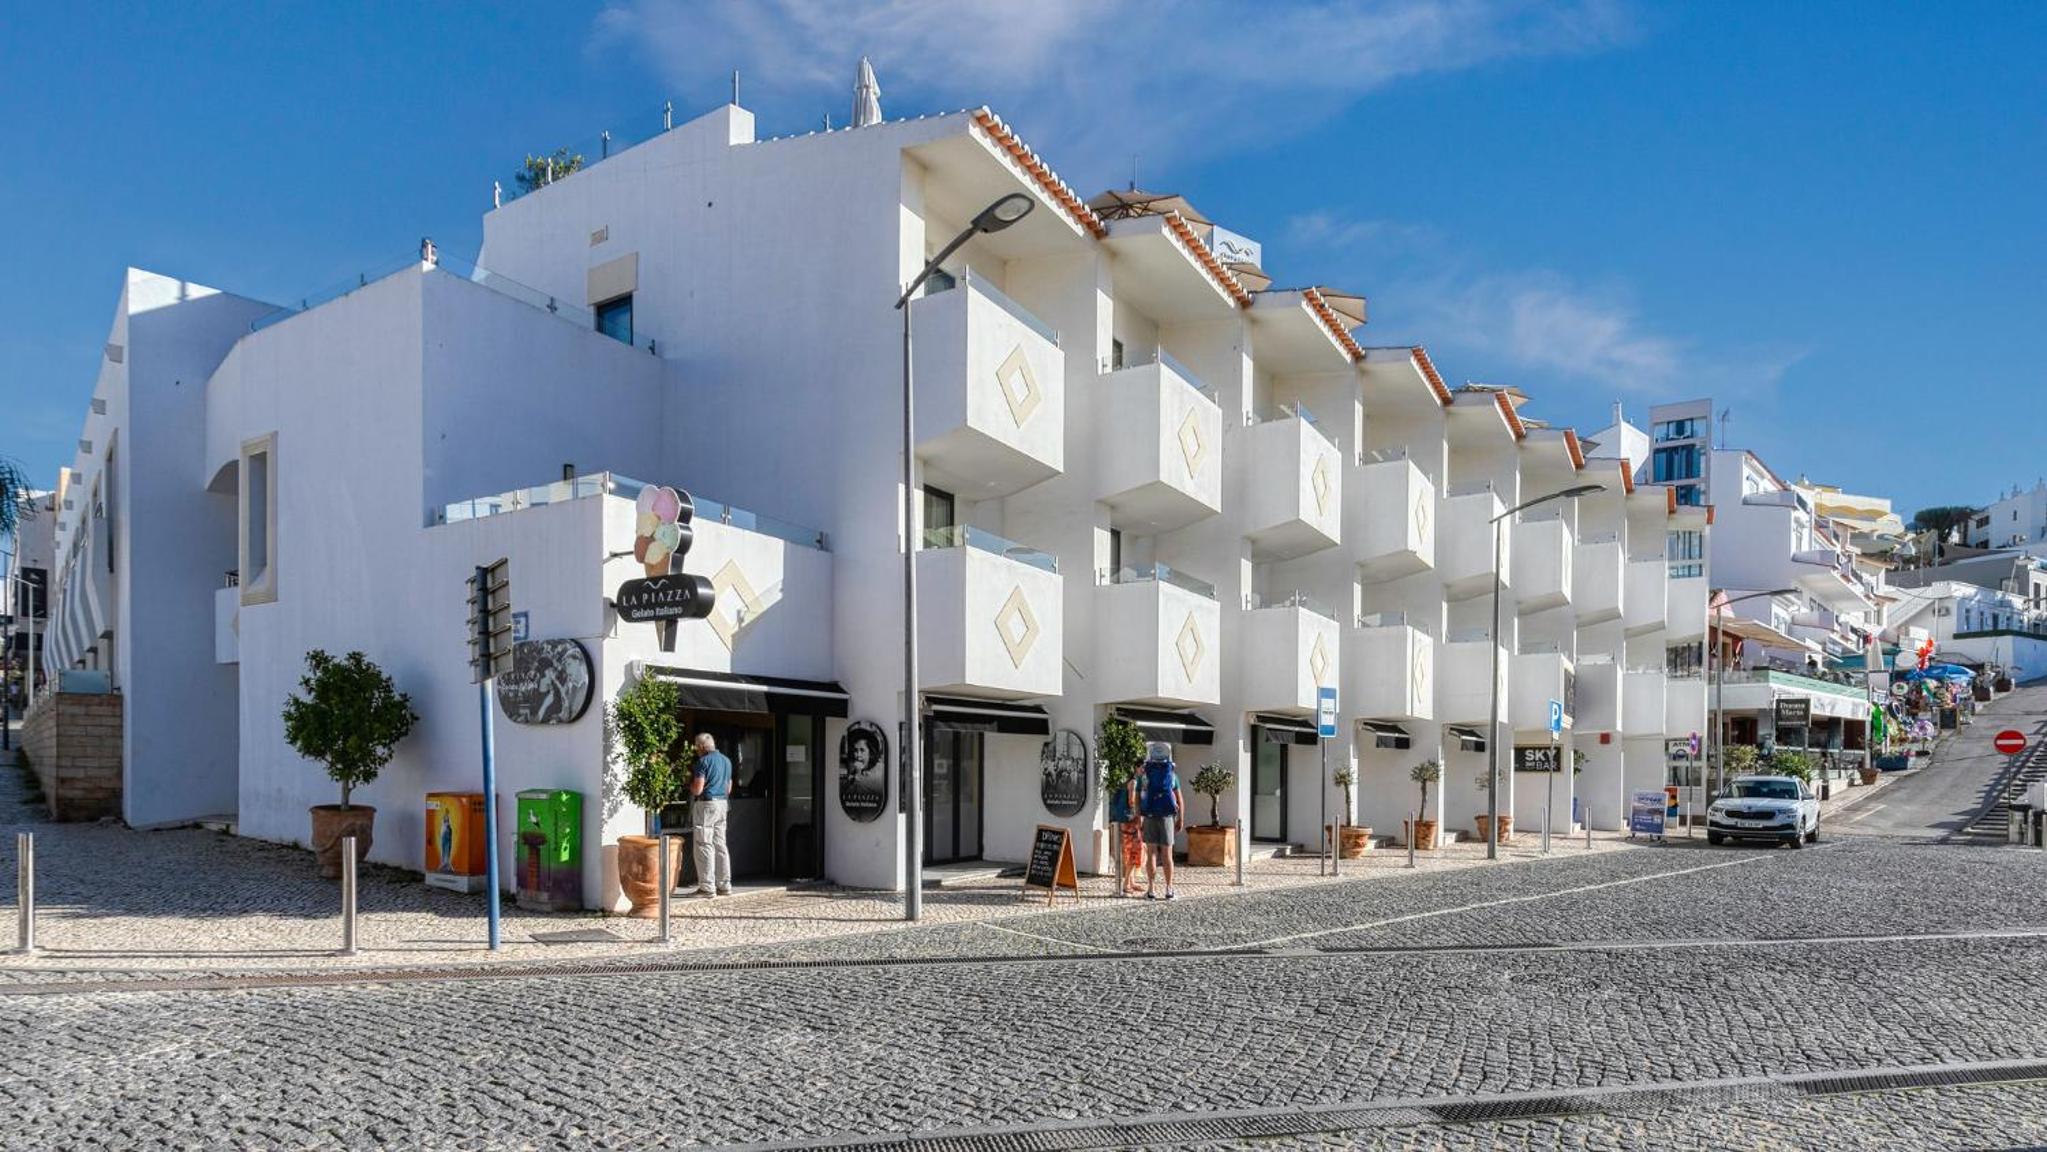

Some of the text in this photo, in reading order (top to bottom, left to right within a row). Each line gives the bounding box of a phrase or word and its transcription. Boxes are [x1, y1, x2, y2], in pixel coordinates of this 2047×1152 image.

[623, 589, 690, 606] LA PIAZZA
[632, 606, 682, 618] Gelato Italiano
[1552, 703, 1559, 728] P
[1525, 749, 1556, 760] SKY
